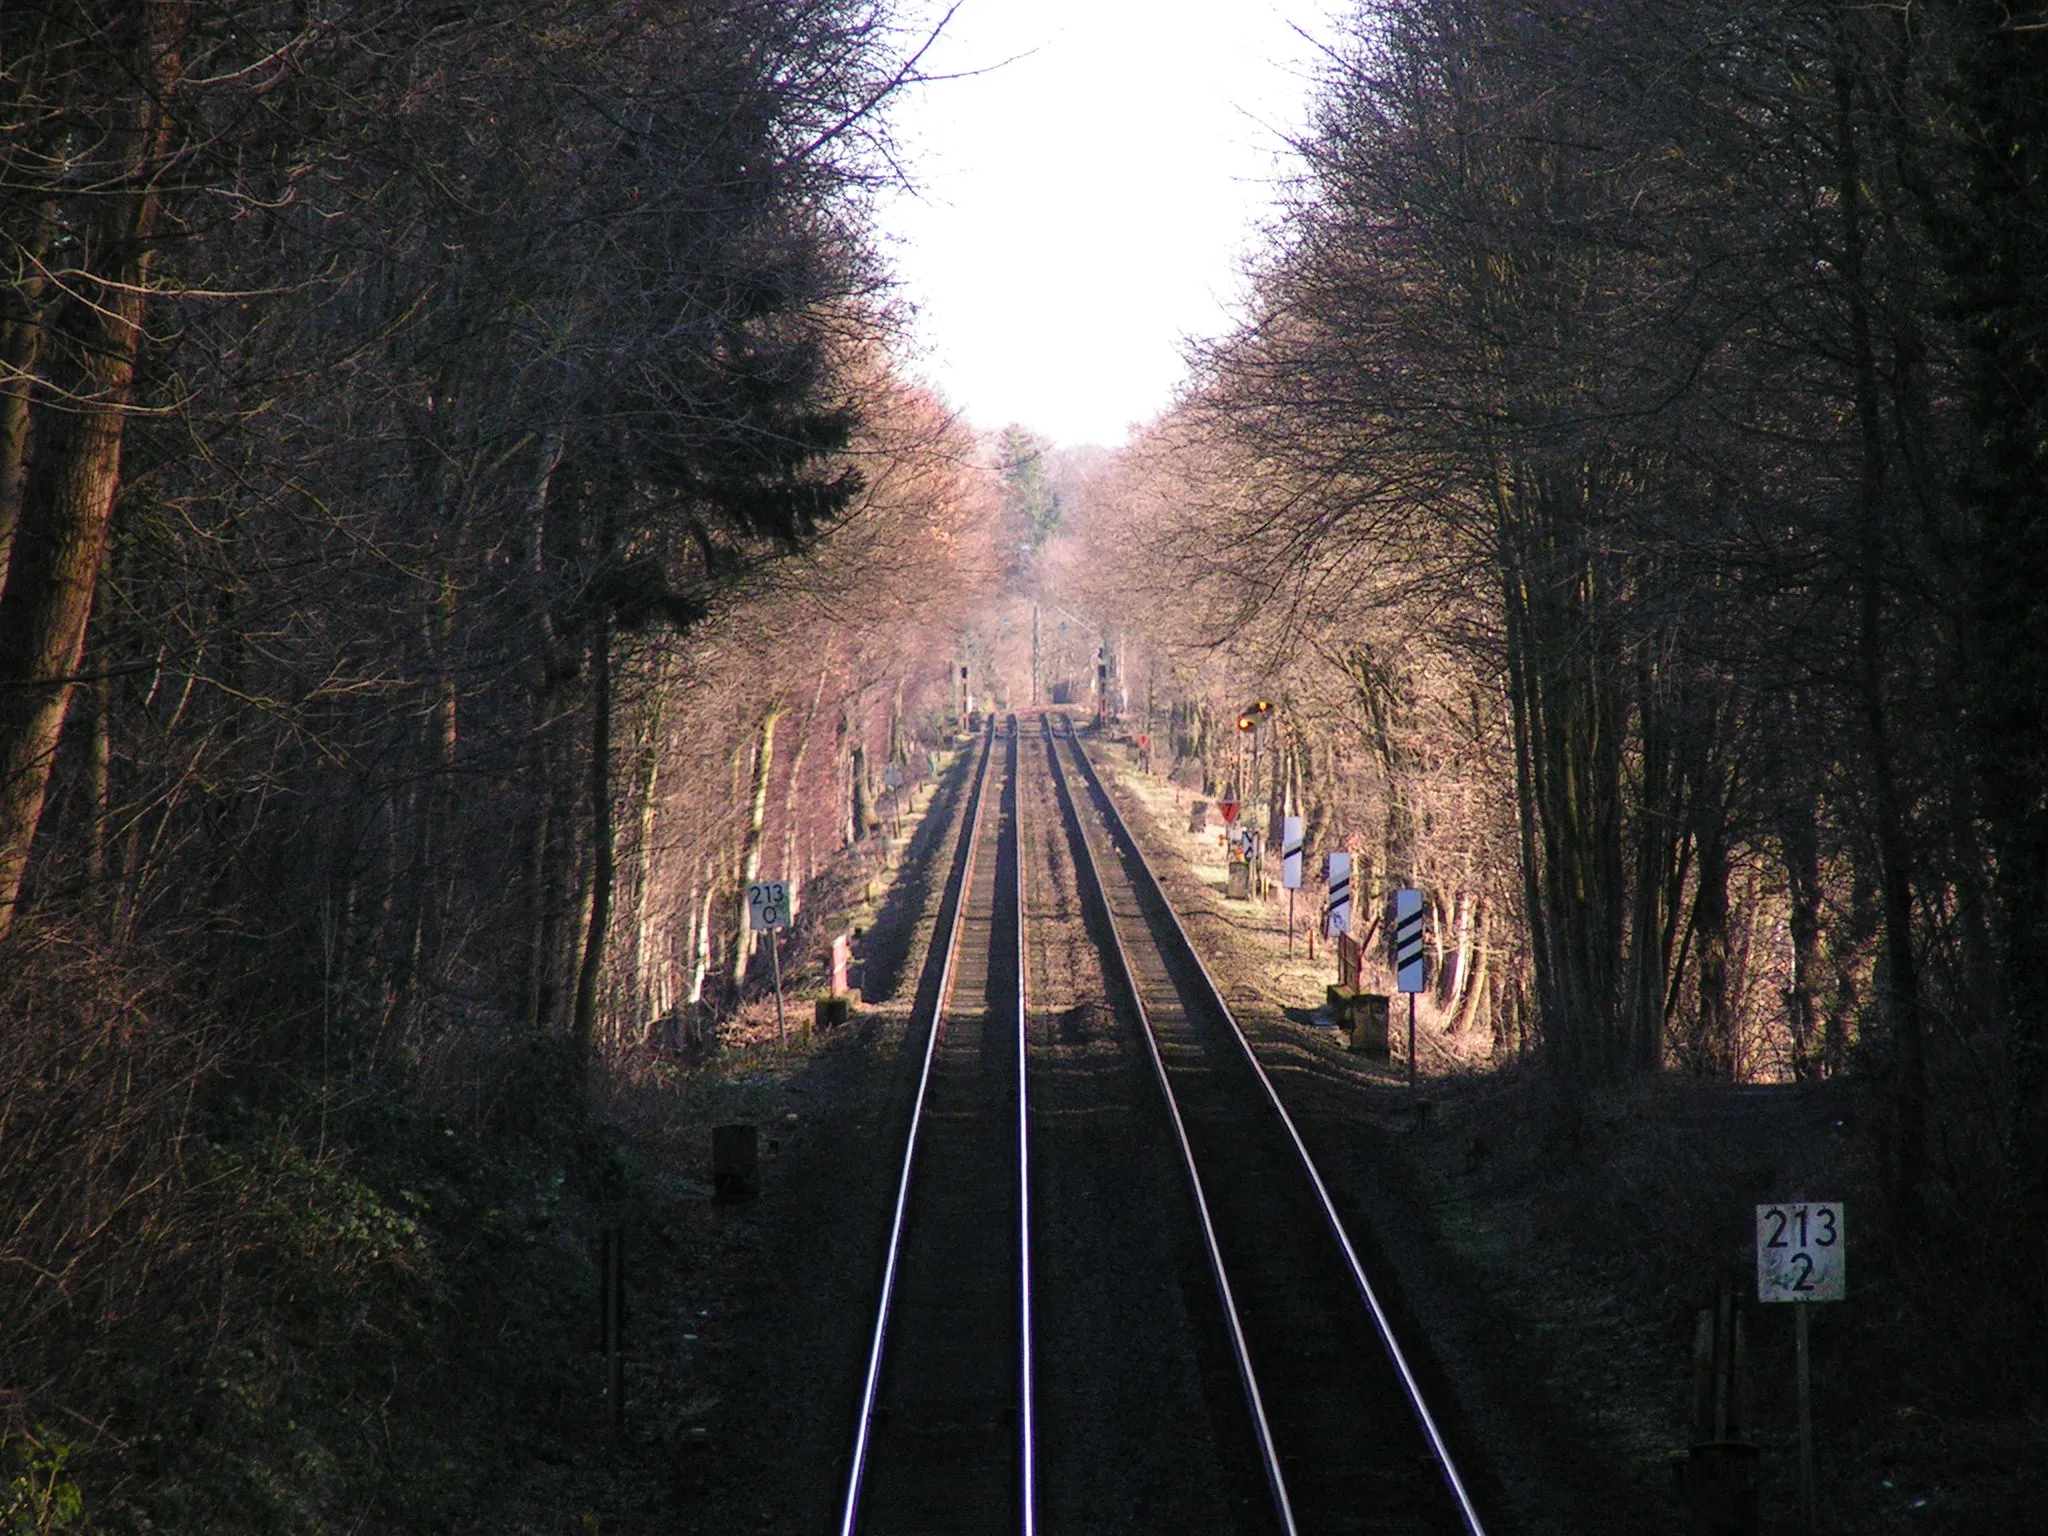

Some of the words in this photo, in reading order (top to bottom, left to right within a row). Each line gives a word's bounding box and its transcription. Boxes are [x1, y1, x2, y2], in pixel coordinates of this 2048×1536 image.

[750, 884, 785, 905] 213
[763, 906, 777, 924] 0
[1764, 1207, 1837, 1248] 213
[1790, 1252, 1815, 1292] 2
